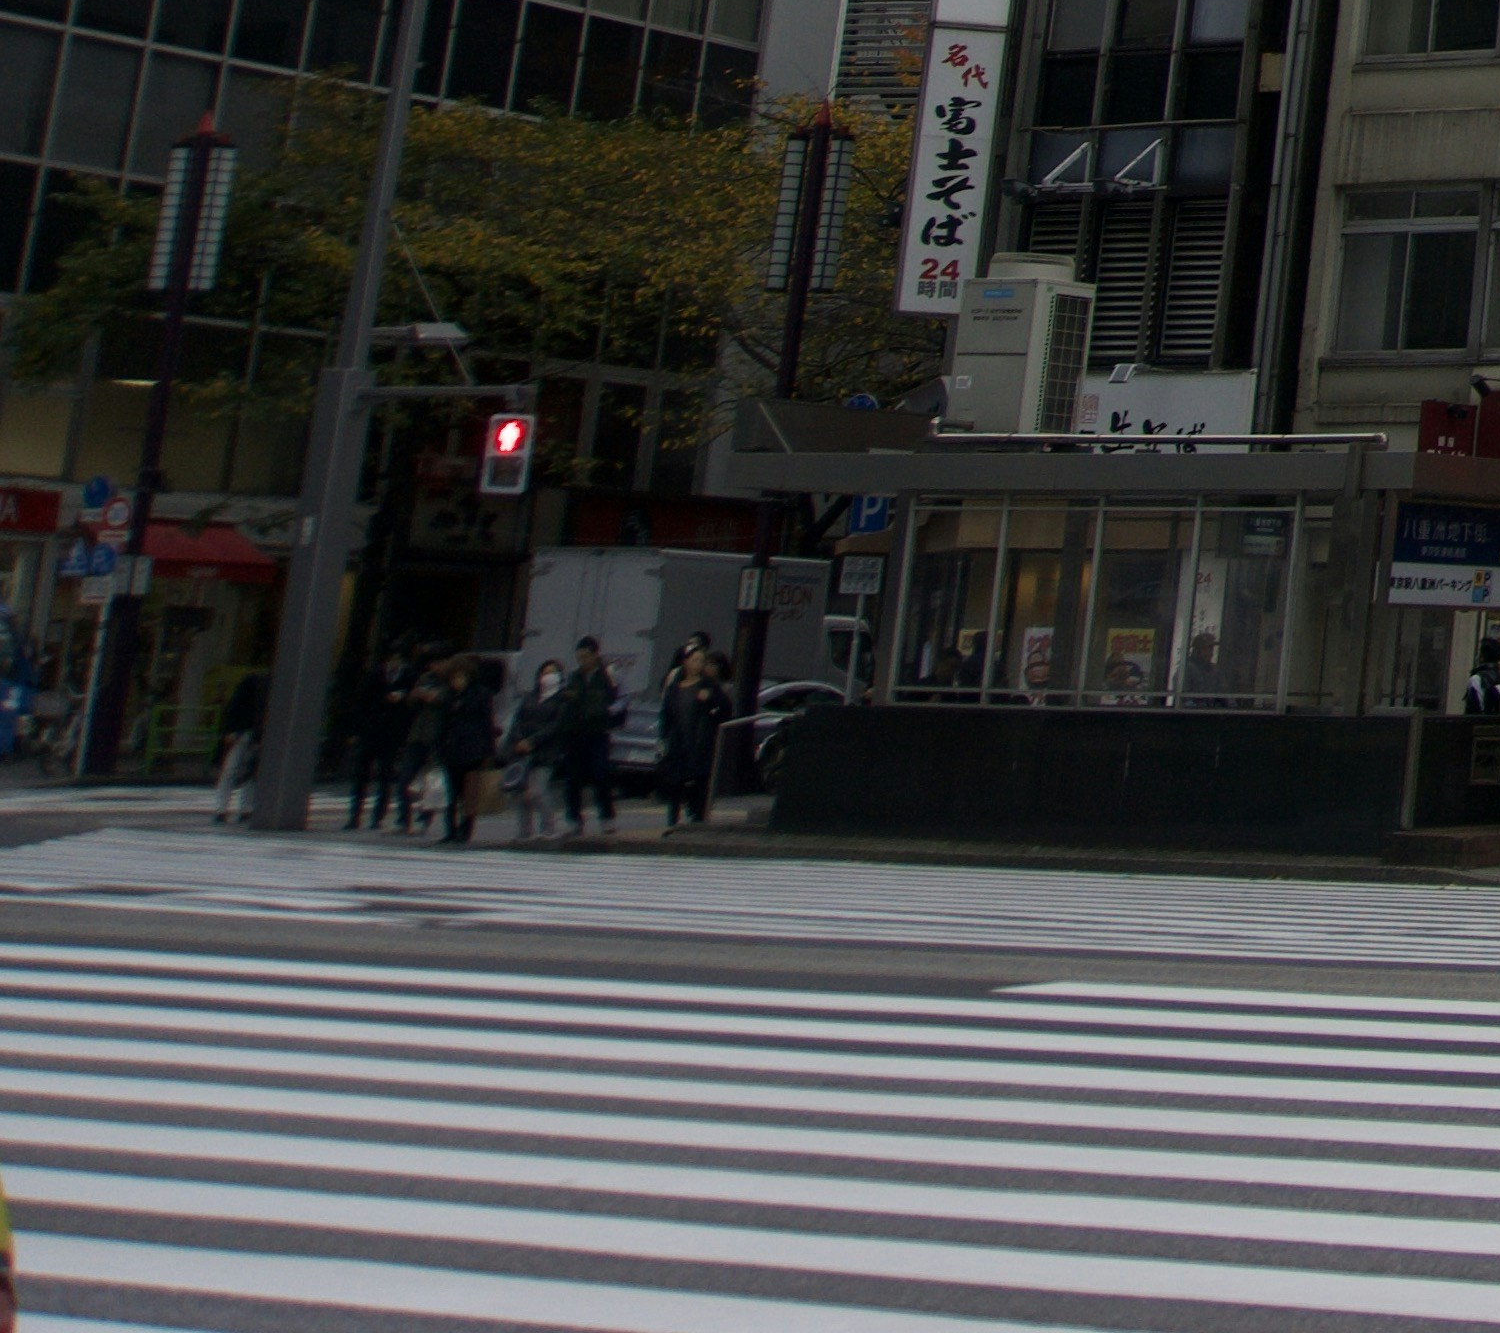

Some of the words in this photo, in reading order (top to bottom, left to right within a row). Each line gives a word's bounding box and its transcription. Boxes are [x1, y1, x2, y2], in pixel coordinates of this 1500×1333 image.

[921, 96, 982, 247] 富士そば
[920, 258, 960, 280] 24
[917, 281, 958, 300] 時間
